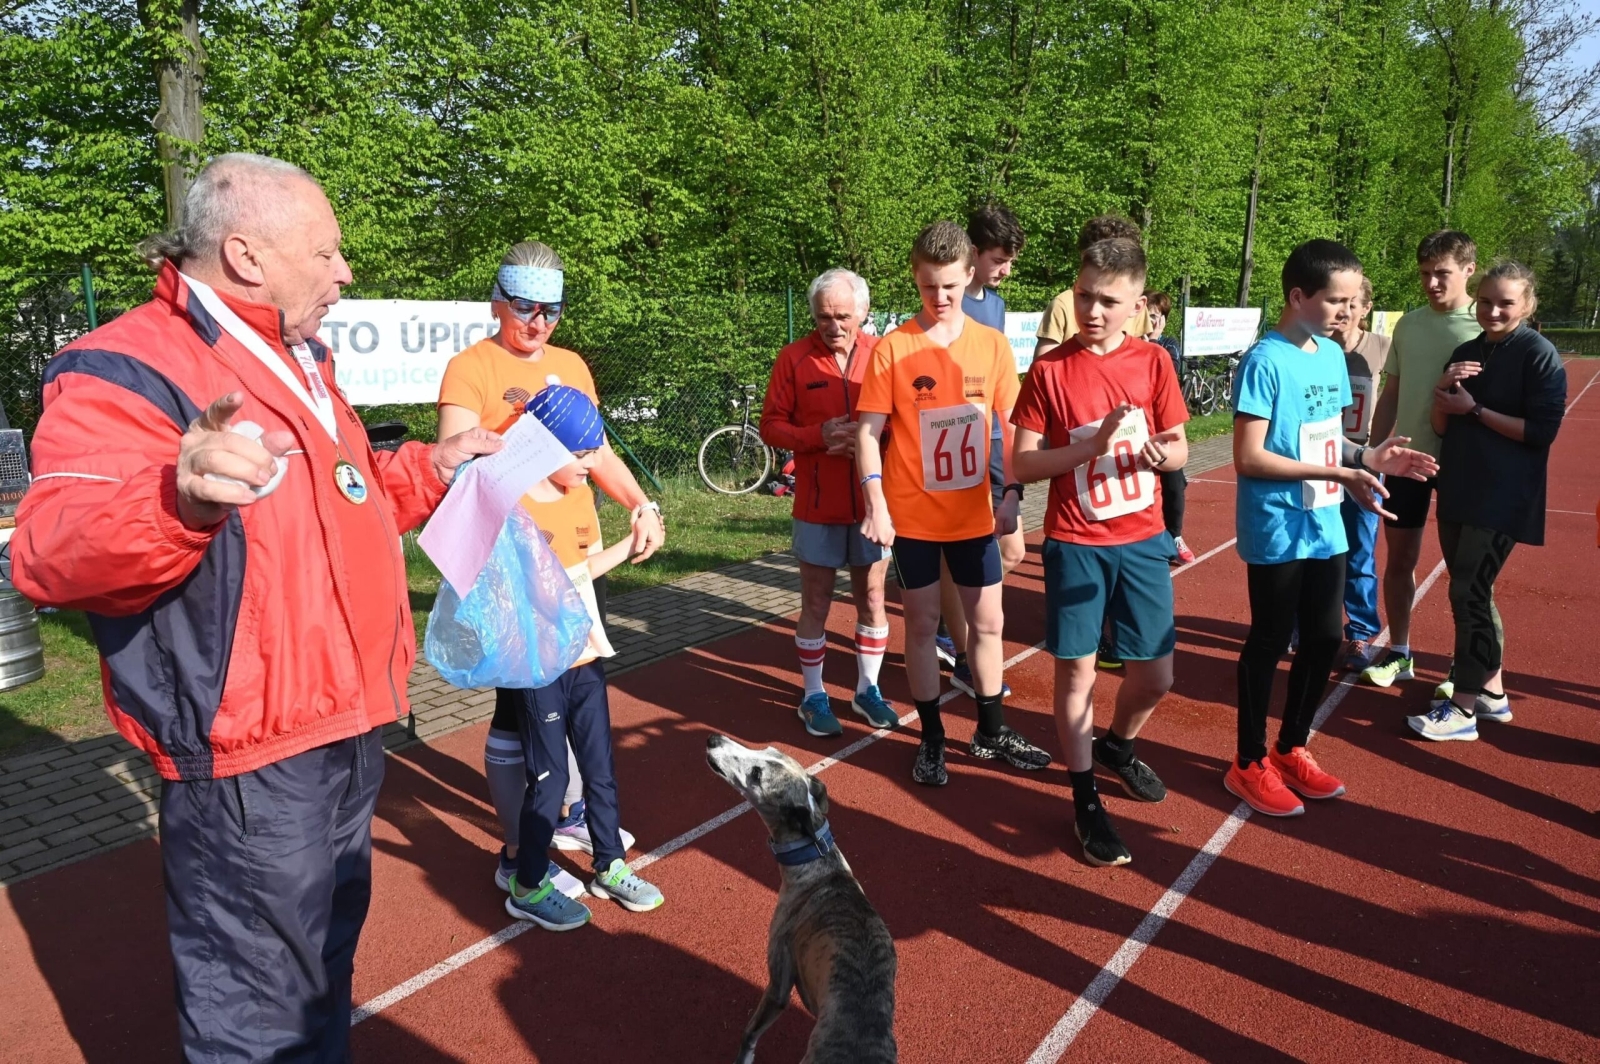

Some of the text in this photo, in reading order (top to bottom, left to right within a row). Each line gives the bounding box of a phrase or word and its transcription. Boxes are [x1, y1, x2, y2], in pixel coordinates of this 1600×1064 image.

[1009, 337, 1037, 349] PARTN
[930, 412, 979, 430] PIVOVAR TRUTNOV
[1116, 425, 1137, 439] UTNOV
[933, 423, 977, 482] 66
[1086, 440, 1142, 509] 68
